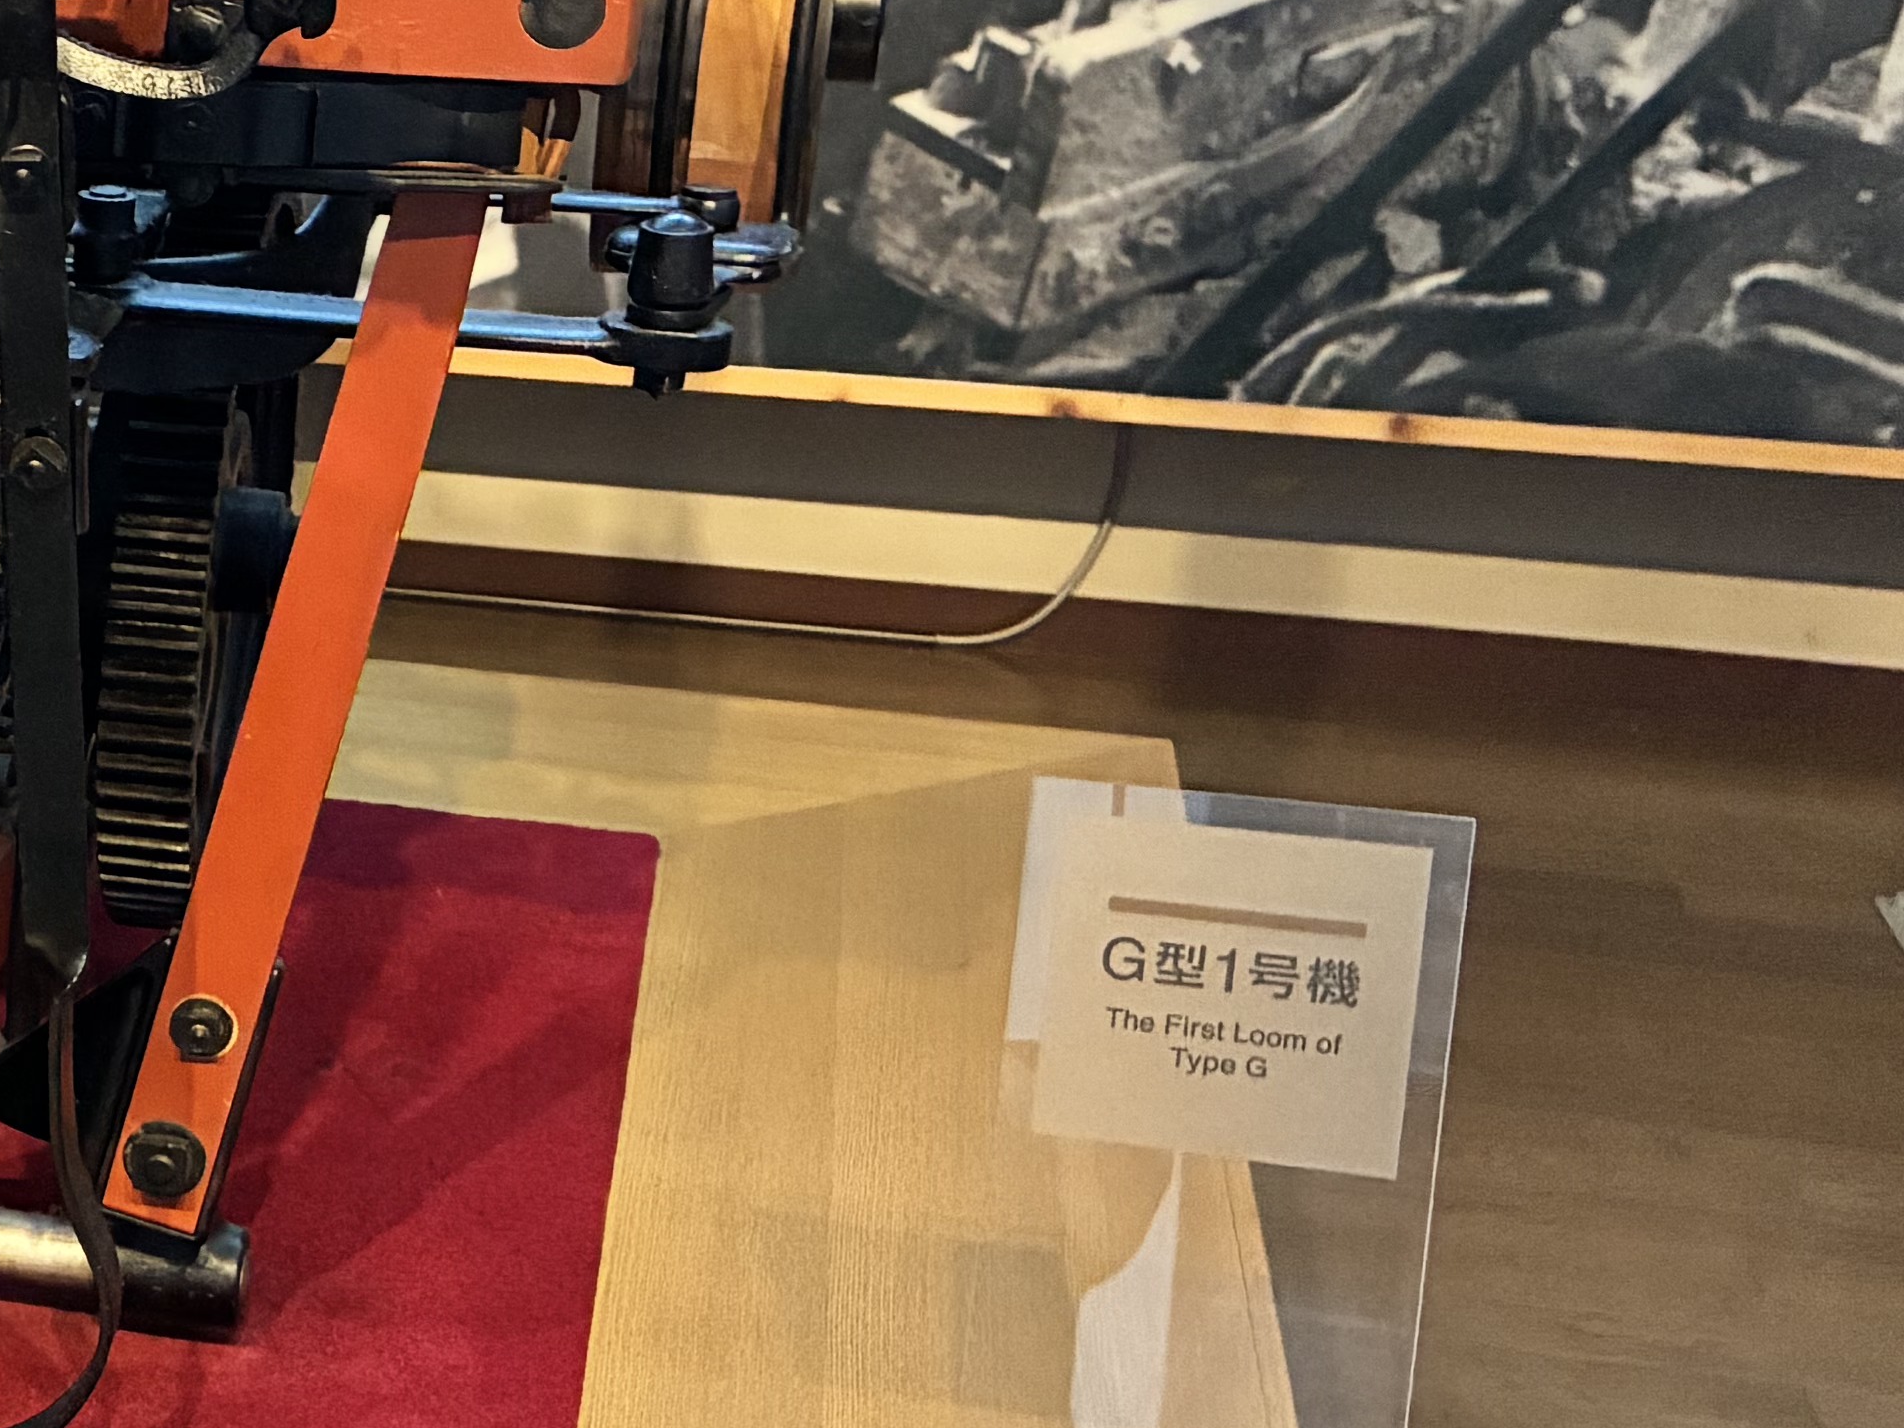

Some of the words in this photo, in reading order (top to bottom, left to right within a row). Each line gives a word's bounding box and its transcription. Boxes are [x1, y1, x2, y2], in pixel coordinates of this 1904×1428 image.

[1101, 935, 1361, 1008] G型1号機
[1105, 1006, 1155, 1034] The
[1164, 1012, 1225, 1041] First
[1233, 1021, 1308, 1053] Loom
[1315, 1033, 1343, 1056] of
[1169, 1045, 1237, 1076] Type
[1245, 1055, 1268, 1079] G
